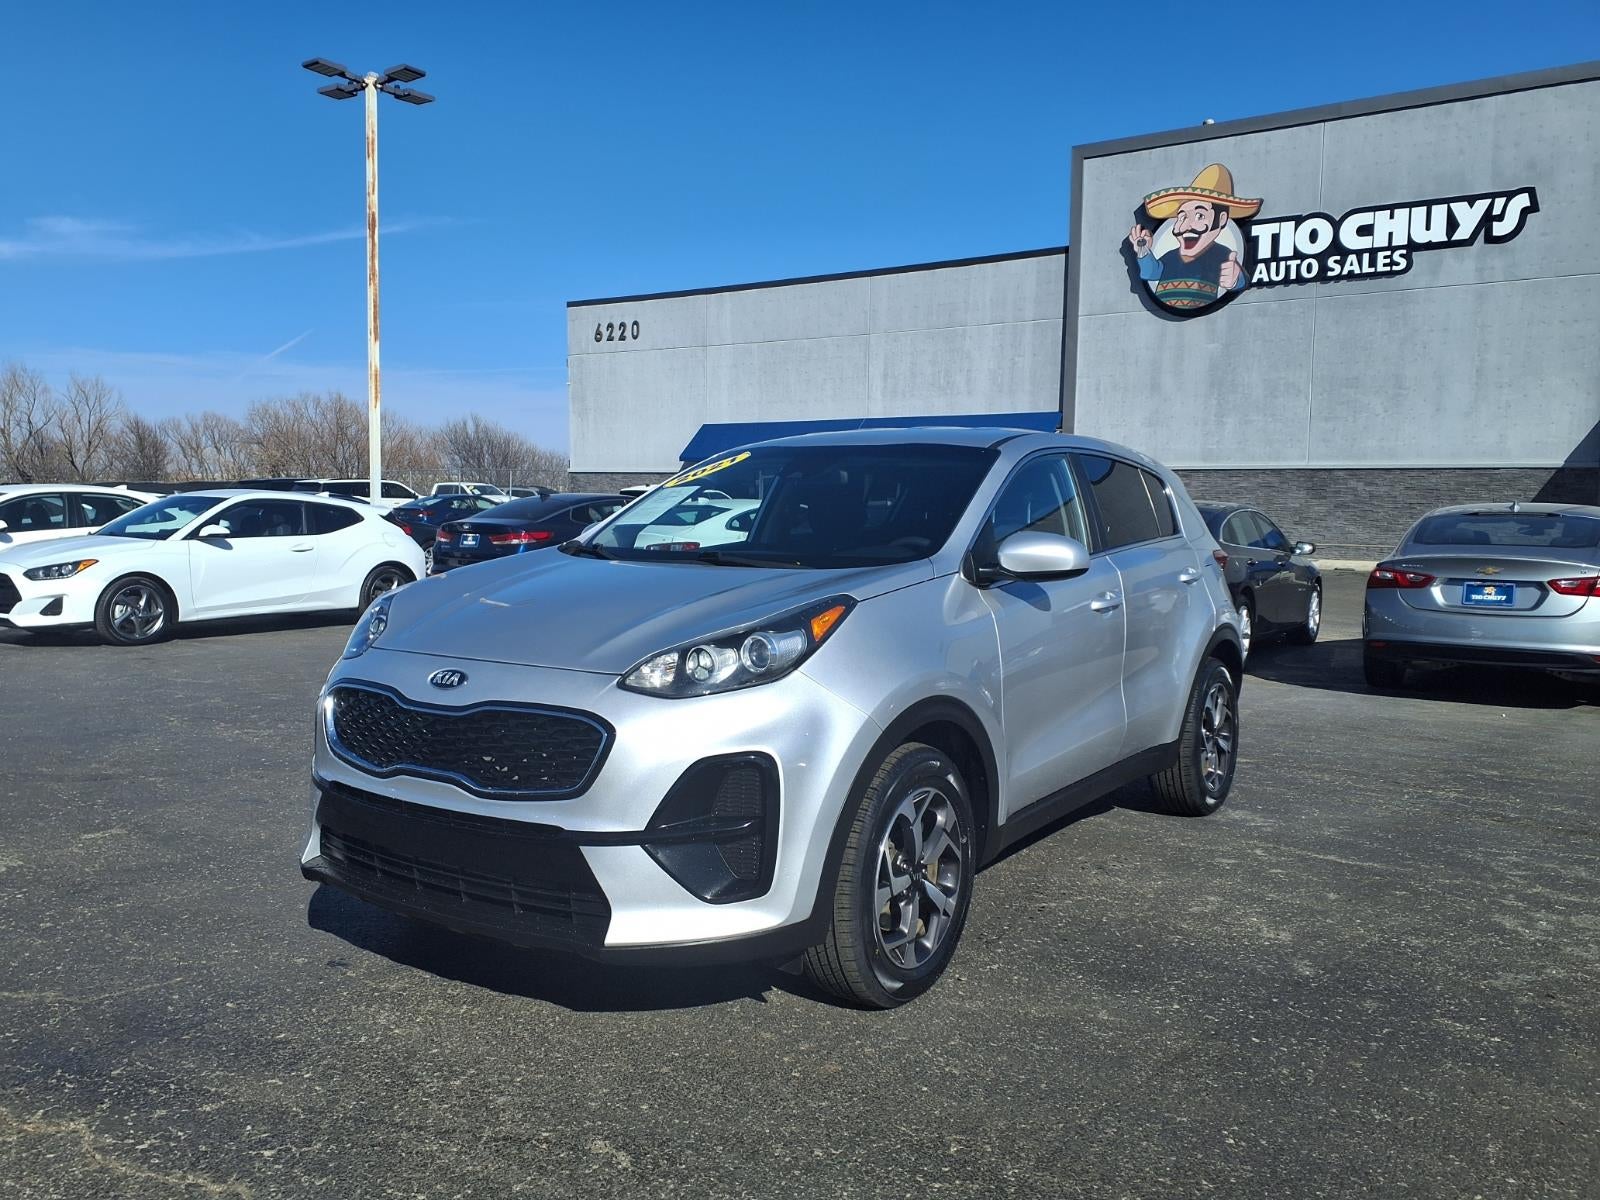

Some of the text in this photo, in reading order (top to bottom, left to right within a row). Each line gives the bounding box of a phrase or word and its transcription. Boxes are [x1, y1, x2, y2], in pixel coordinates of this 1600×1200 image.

[1251, 192, 1531, 259] TIO CHUY'S
[1251, 250, 1407, 283] AUTO SALES
[594, 320, 640, 342] 6220
[432, 671, 461, 686] KIA
